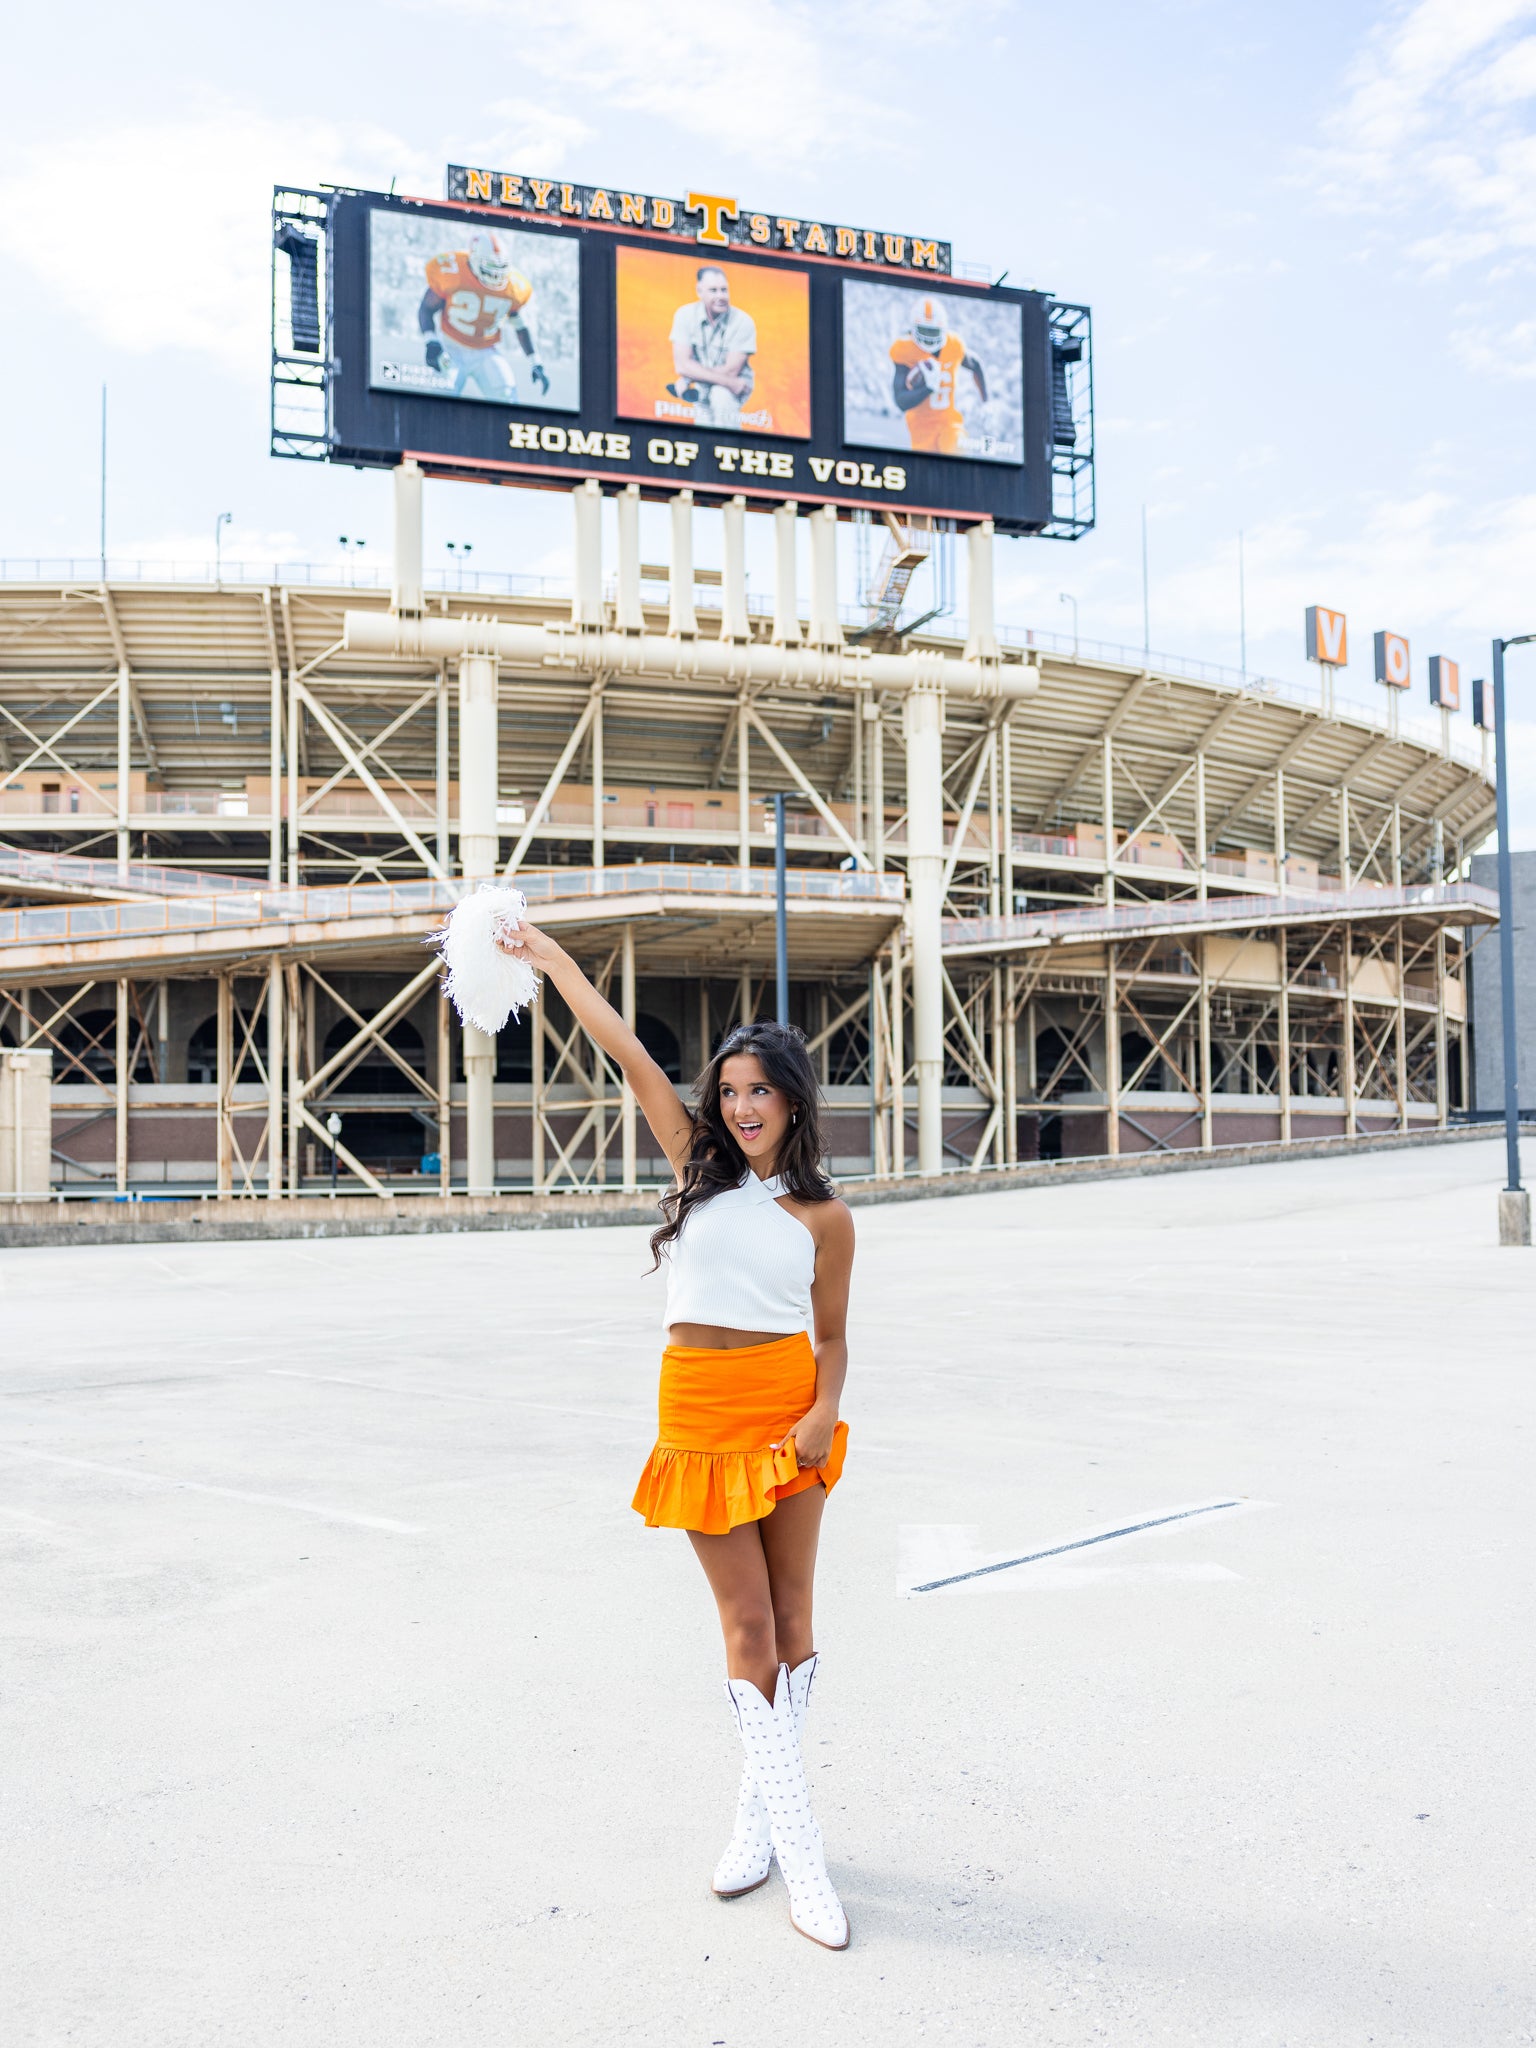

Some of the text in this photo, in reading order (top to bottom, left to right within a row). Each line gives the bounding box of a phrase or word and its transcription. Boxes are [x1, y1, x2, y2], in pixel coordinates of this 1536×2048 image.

[466, 168, 939, 269] NEYLAND T STADIUM
[448, 290, 512, 338] 27
[509, 422, 906, 490] HOME OF THE VOLS
